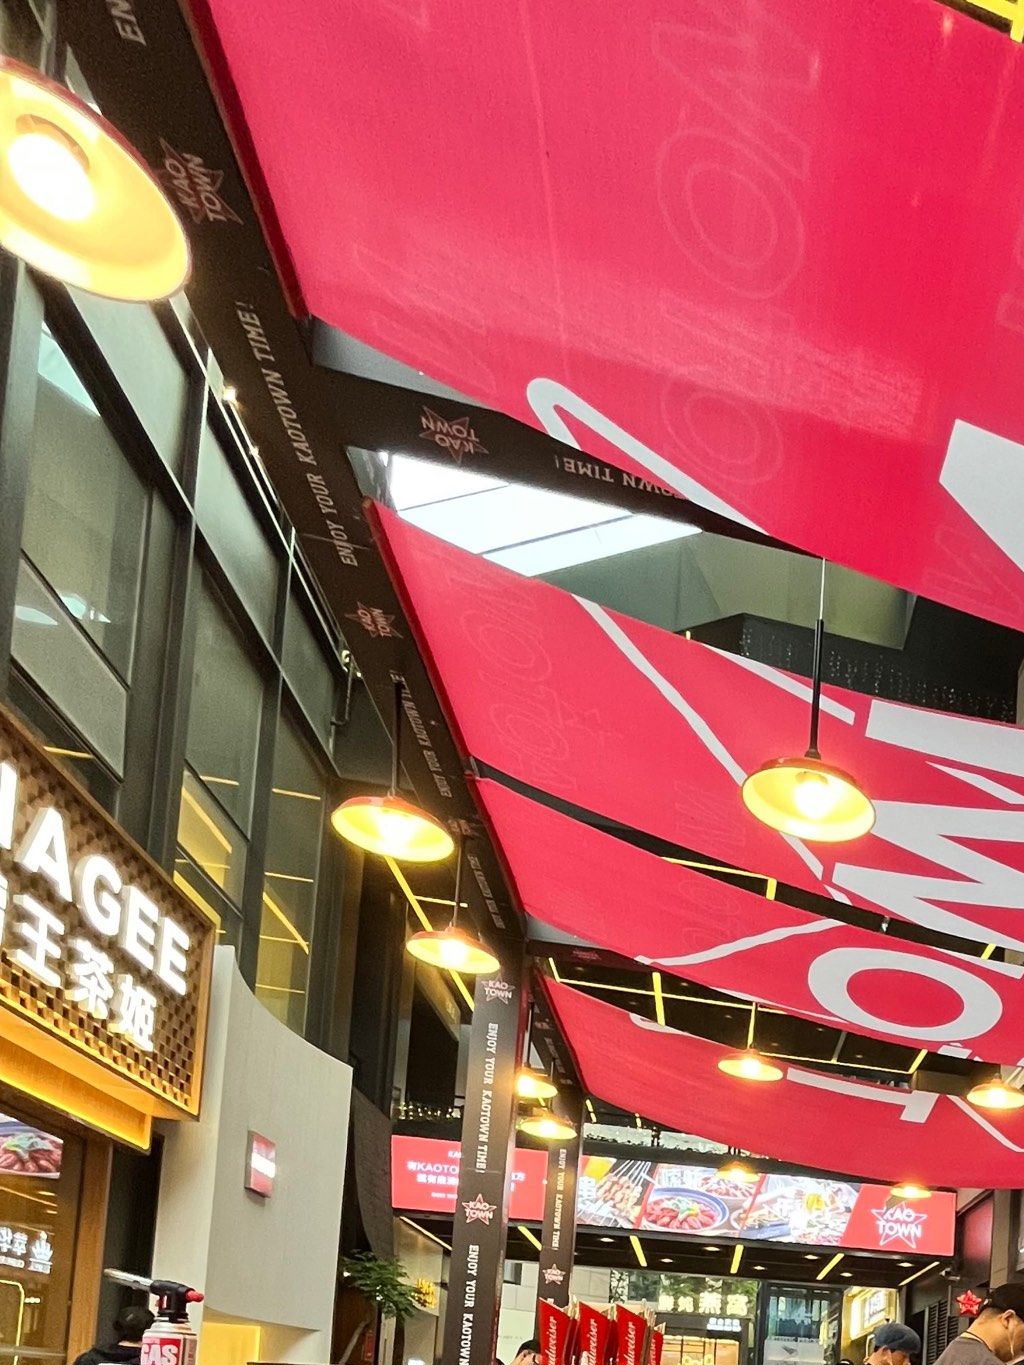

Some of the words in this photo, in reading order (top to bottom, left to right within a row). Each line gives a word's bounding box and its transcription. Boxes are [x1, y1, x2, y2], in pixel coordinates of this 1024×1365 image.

[164, 158, 202, 225] KAO
[182, 151, 228, 222] TOWN
[236, 300, 275, 362] TIME!
[261, 367, 317, 466] KAOTOWN
[420, 416, 479, 442] TOWN
[435, 433, 474, 454] KAO
[555, 454, 615, 483] TIME!
[306, 472, 338, 520] YOUR
[326, 519, 358, 567] ENJOY
[0, 872, 157, 1053] 王茶姬
[484, 988, 512, 1000] TOWN
[488, 979, 509, 990] KAO
[486, 1022, 499, 1052] ENJOY
[484, 1057, 496, 1085] YOUR
[478, 1089, 493, 1143] KAOTOWN
[465, 1208, 493, 1219] TOWN
[469, 1200, 490, 1211] KAO
[884, 1206, 915, 1222] KAO
[876, 1220, 922, 1238] TOWN
[467, 1244, 480, 1276] ENJOY
[464, 1278, 477, 1308] YOUR
